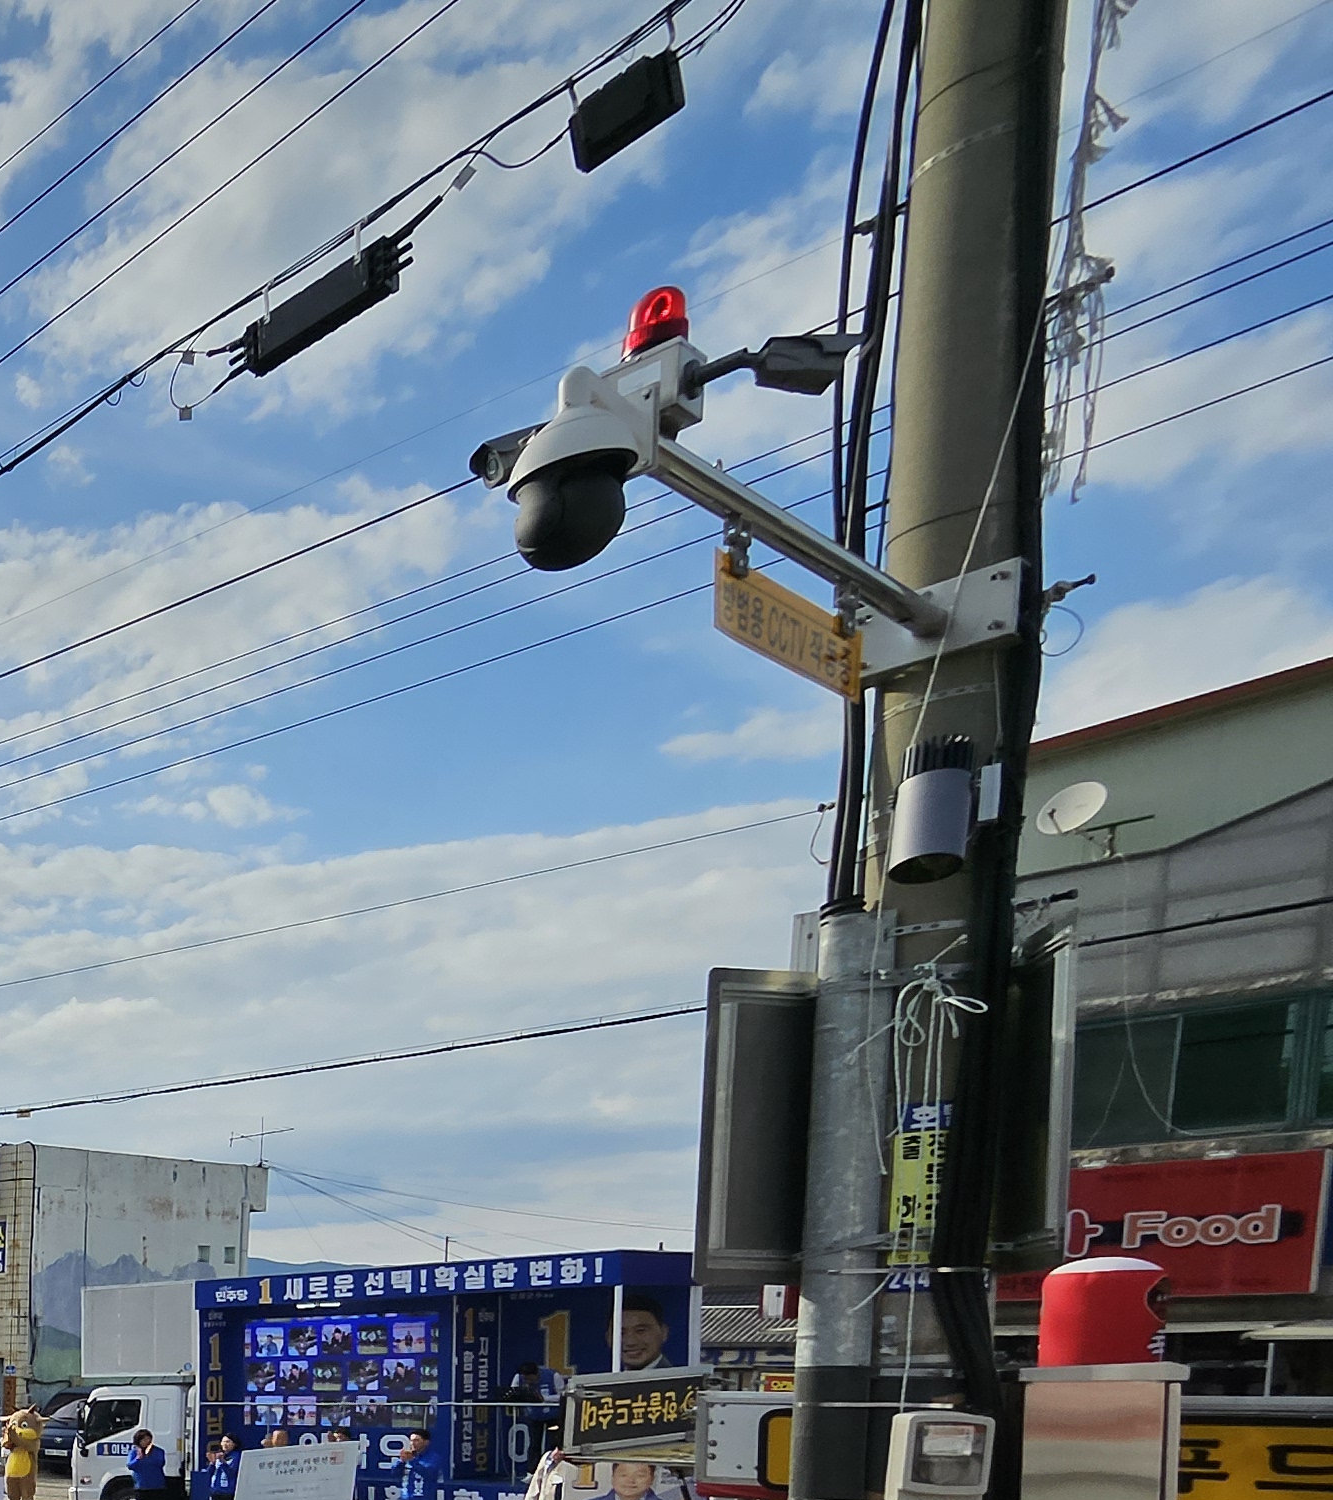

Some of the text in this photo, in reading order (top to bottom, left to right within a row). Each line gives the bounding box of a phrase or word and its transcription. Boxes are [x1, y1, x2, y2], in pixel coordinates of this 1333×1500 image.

[766, 605, 808, 662] CCTV
[1121, 1204, 1282, 1249] Food
[215, 1289, 248, 1303] 민주당
[258, 1278, 272, 1304] 1
[283, 1257, 604, 1301] 새로운 선택! 확실한 변화!
[209, 1333, 221, 1371] 1
[538, 1309, 578, 1377] 1
[580, 1391, 678, 1432] 한솔푸드순대
